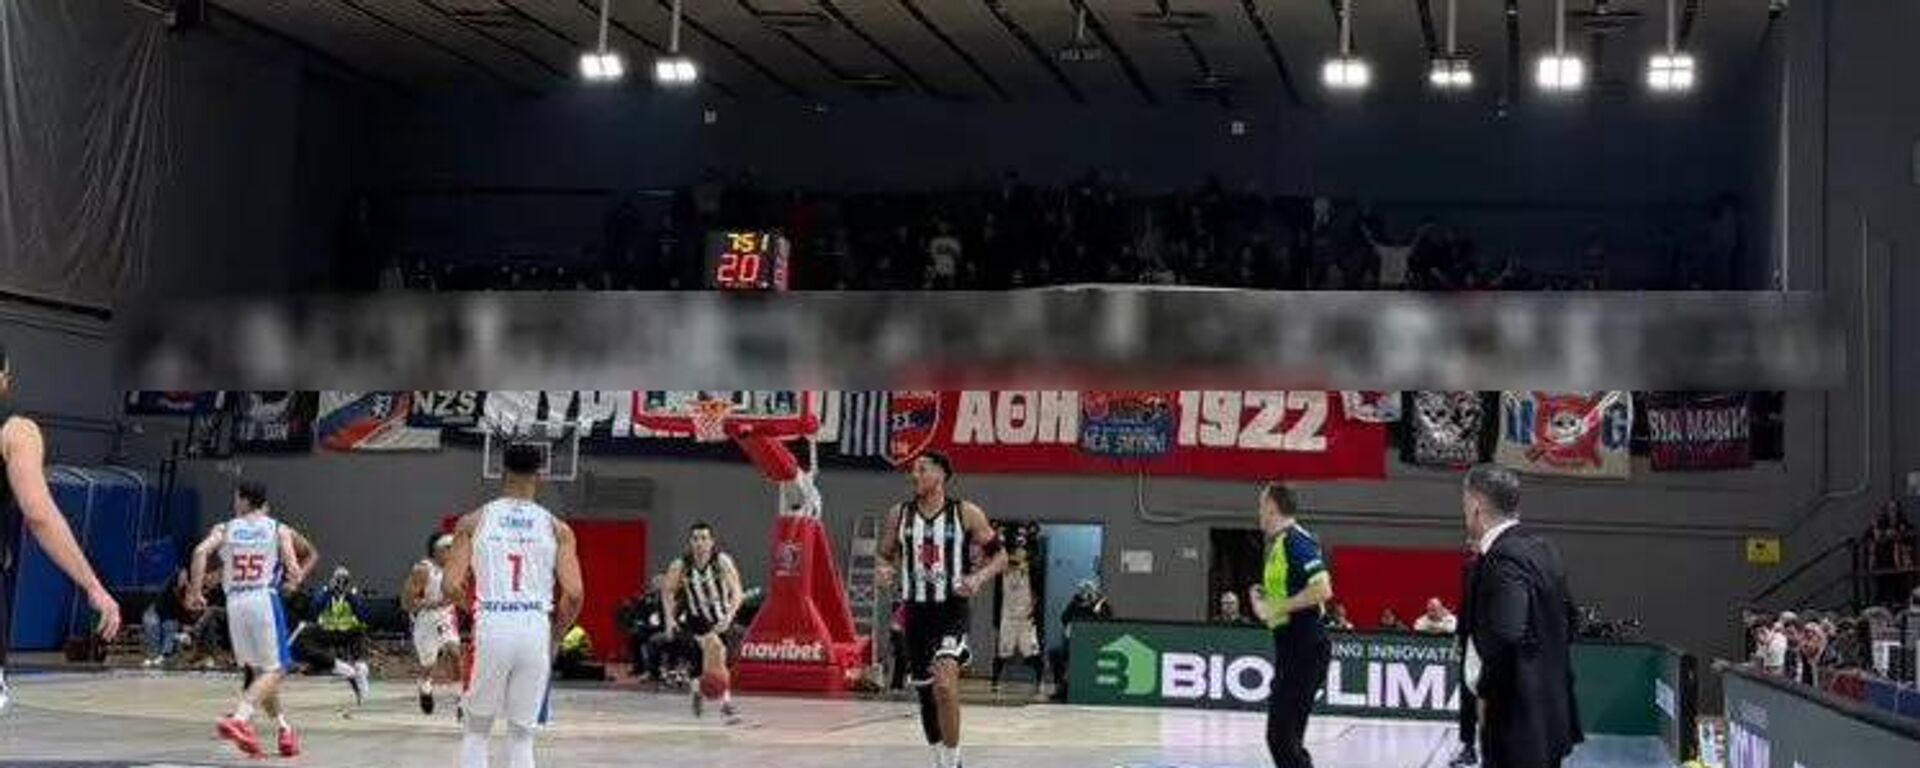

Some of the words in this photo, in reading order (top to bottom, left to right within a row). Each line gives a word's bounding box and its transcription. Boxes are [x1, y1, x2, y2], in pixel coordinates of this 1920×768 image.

[717, 254, 759, 281] 20
[952, 390, 1078, 443] ΑΘΗ
[1178, 390, 1327, 451] 1922
[233, 554, 264, 581] 55
[741, 638, 823, 661] novibet
[1161, 652, 1460, 710] BIOLIM
